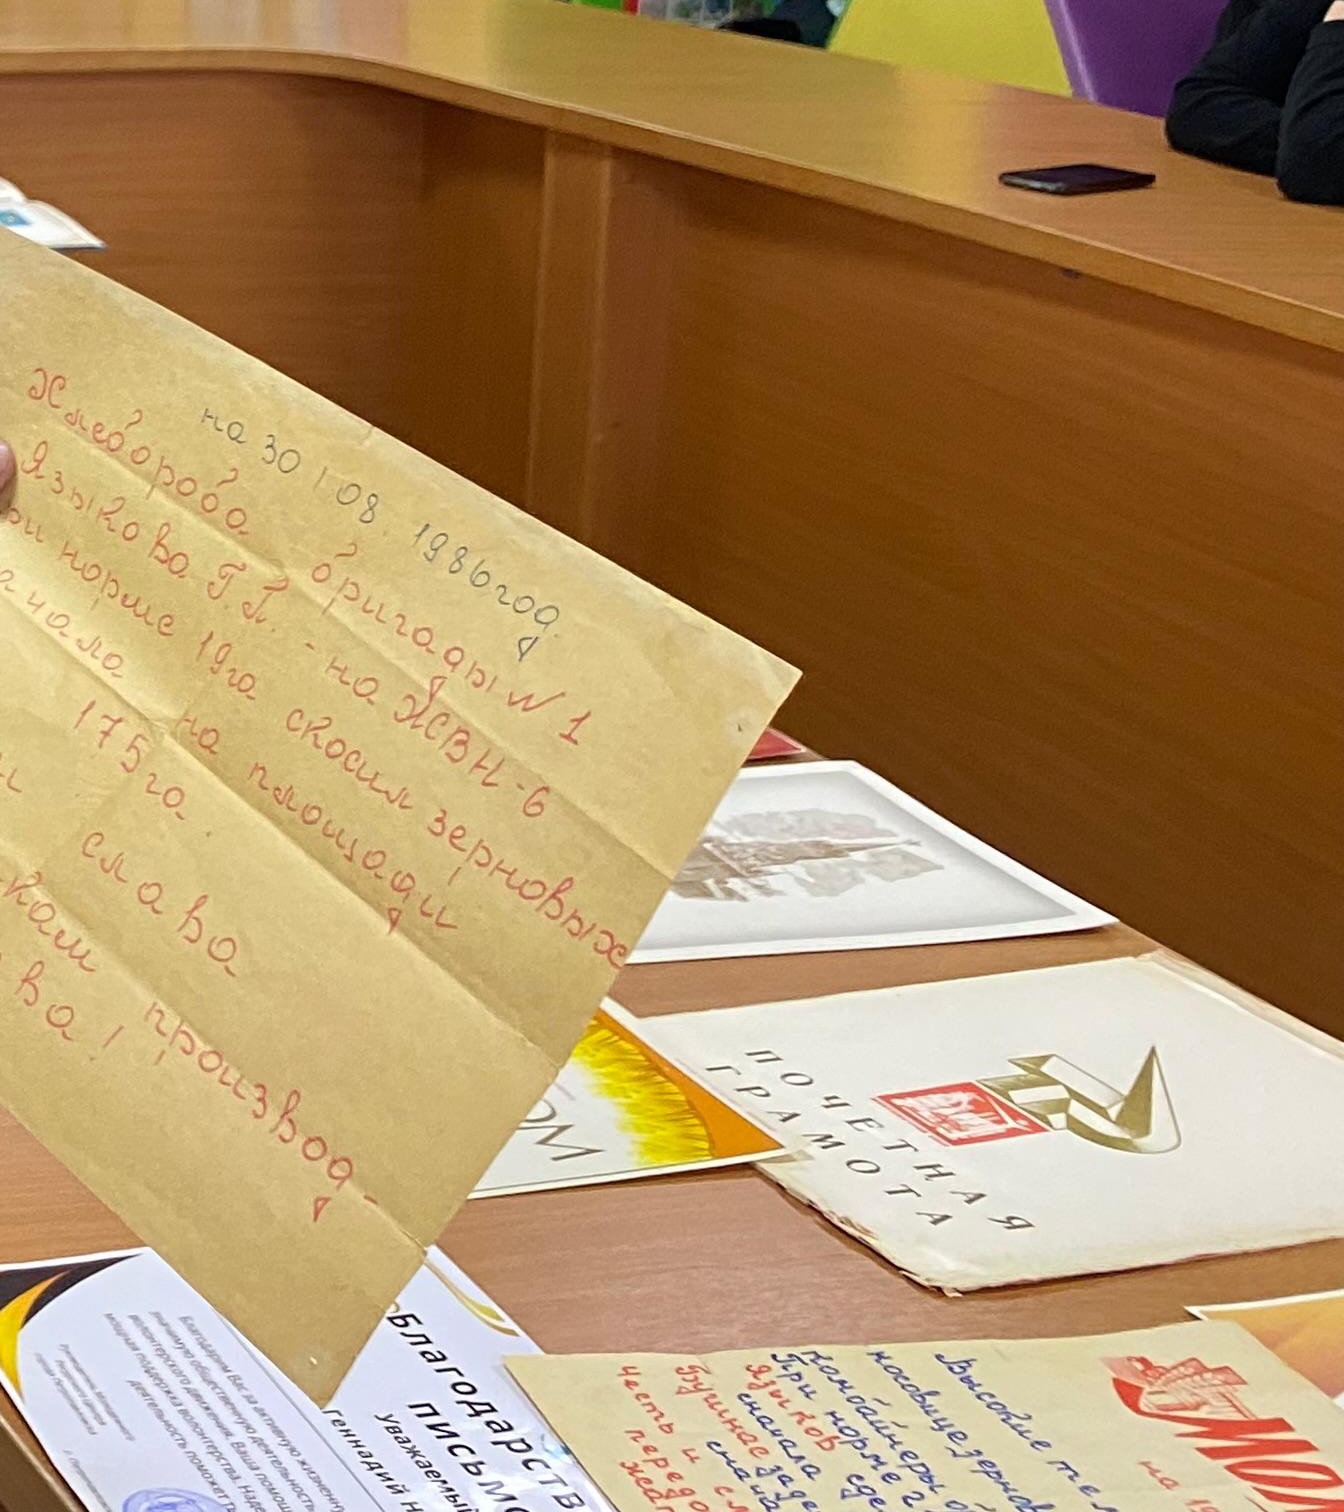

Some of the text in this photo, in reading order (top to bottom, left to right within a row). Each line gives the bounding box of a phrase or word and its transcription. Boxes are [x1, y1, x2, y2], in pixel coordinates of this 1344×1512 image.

[28, 365, 249, 537] Хлебороба
[59, 539, 176, 637] норме
[81, 830, 242, 979] слава
[705, 1064, 953, 1227] ГРАМОТА
[744, 1049, 1036, 1230] ПОЧЕТНАЯ
[322, 1408, 411, 1495] Геннадий
[374, 1412, 480, 1512] Уважаемы
